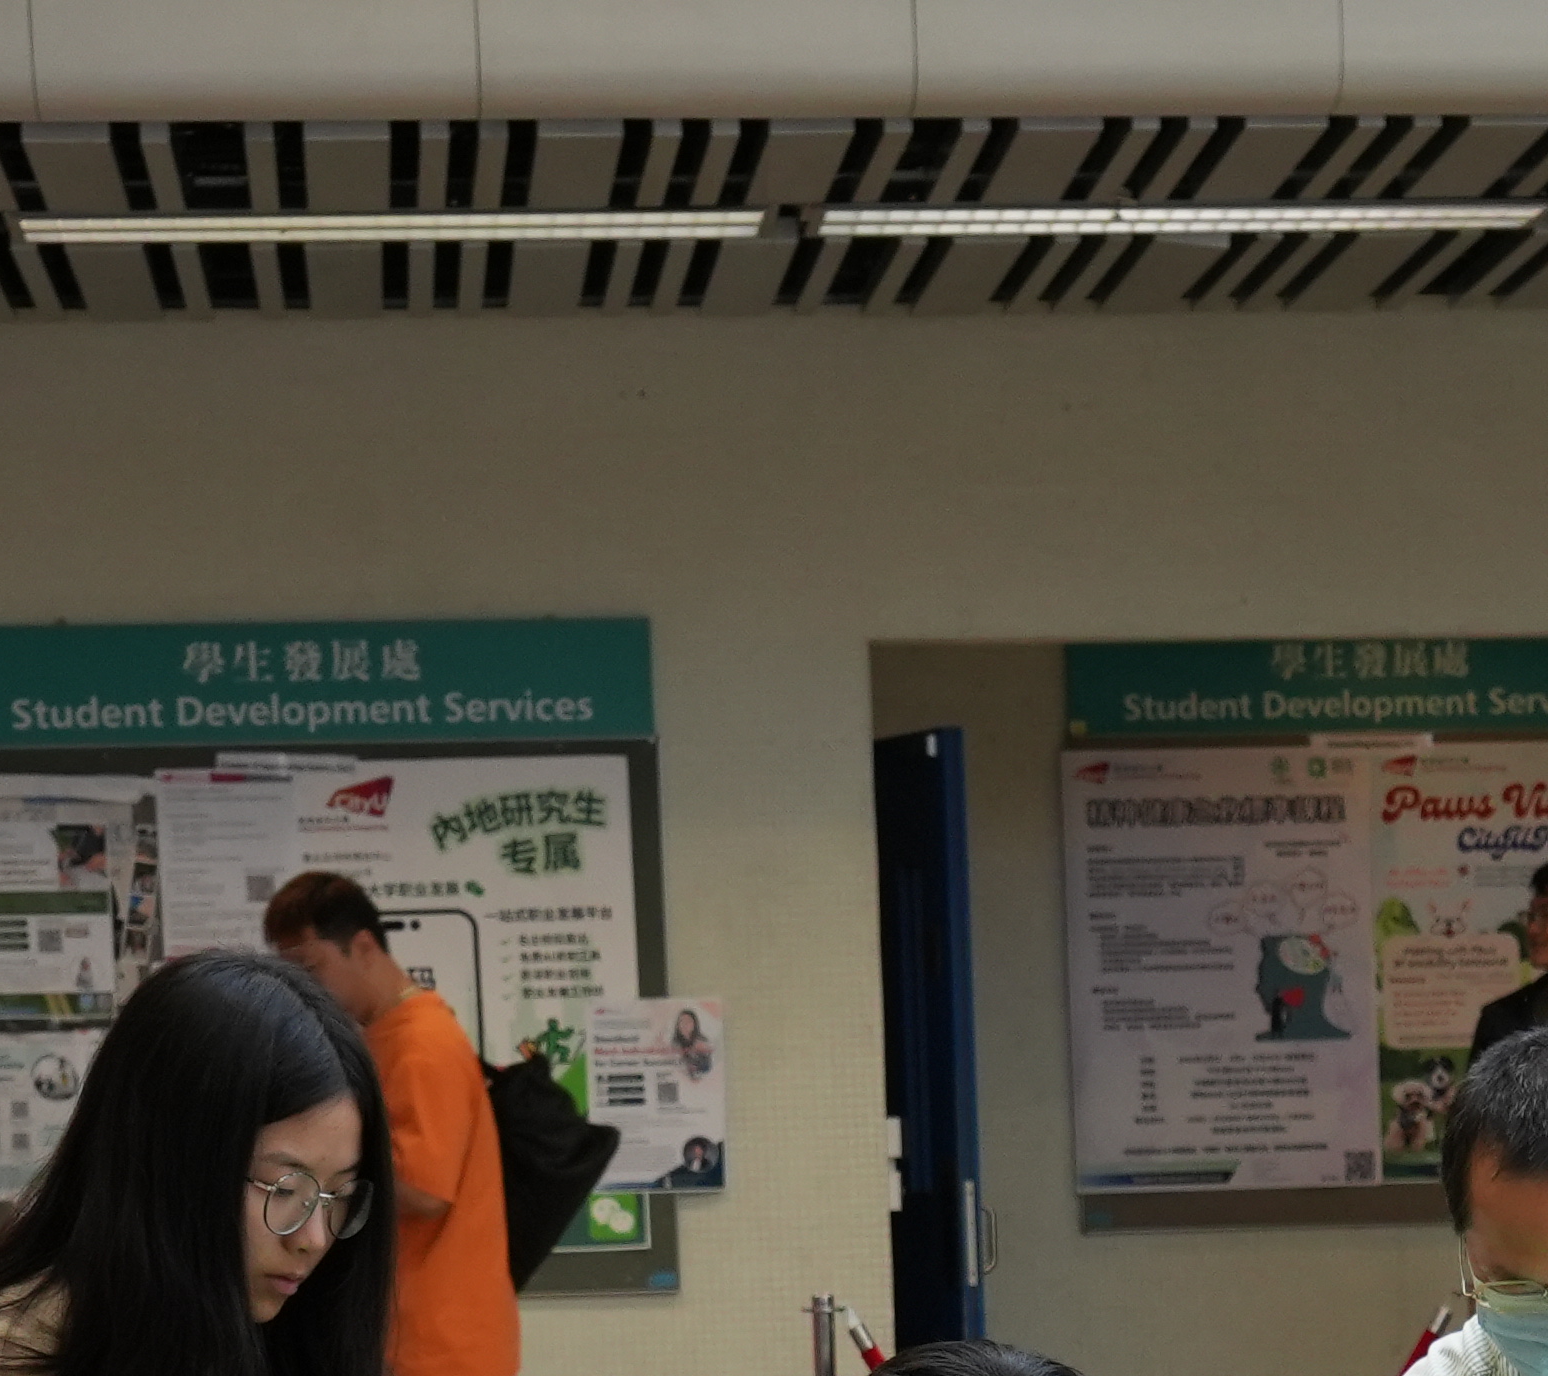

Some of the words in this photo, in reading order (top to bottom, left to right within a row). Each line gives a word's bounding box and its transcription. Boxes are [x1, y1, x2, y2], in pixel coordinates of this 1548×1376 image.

[181, 637, 423, 685] 學生發展處
[10, 696, 165, 732] Student
[175, 691, 432, 733] Development
[441, 689, 596, 725] Services
[1123, 691, 1253, 724] Student
[1261, 688, 1480, 724] Development
[1381, 784, 1496, 824] Paws
[501, 831, 582, 875] 专属
